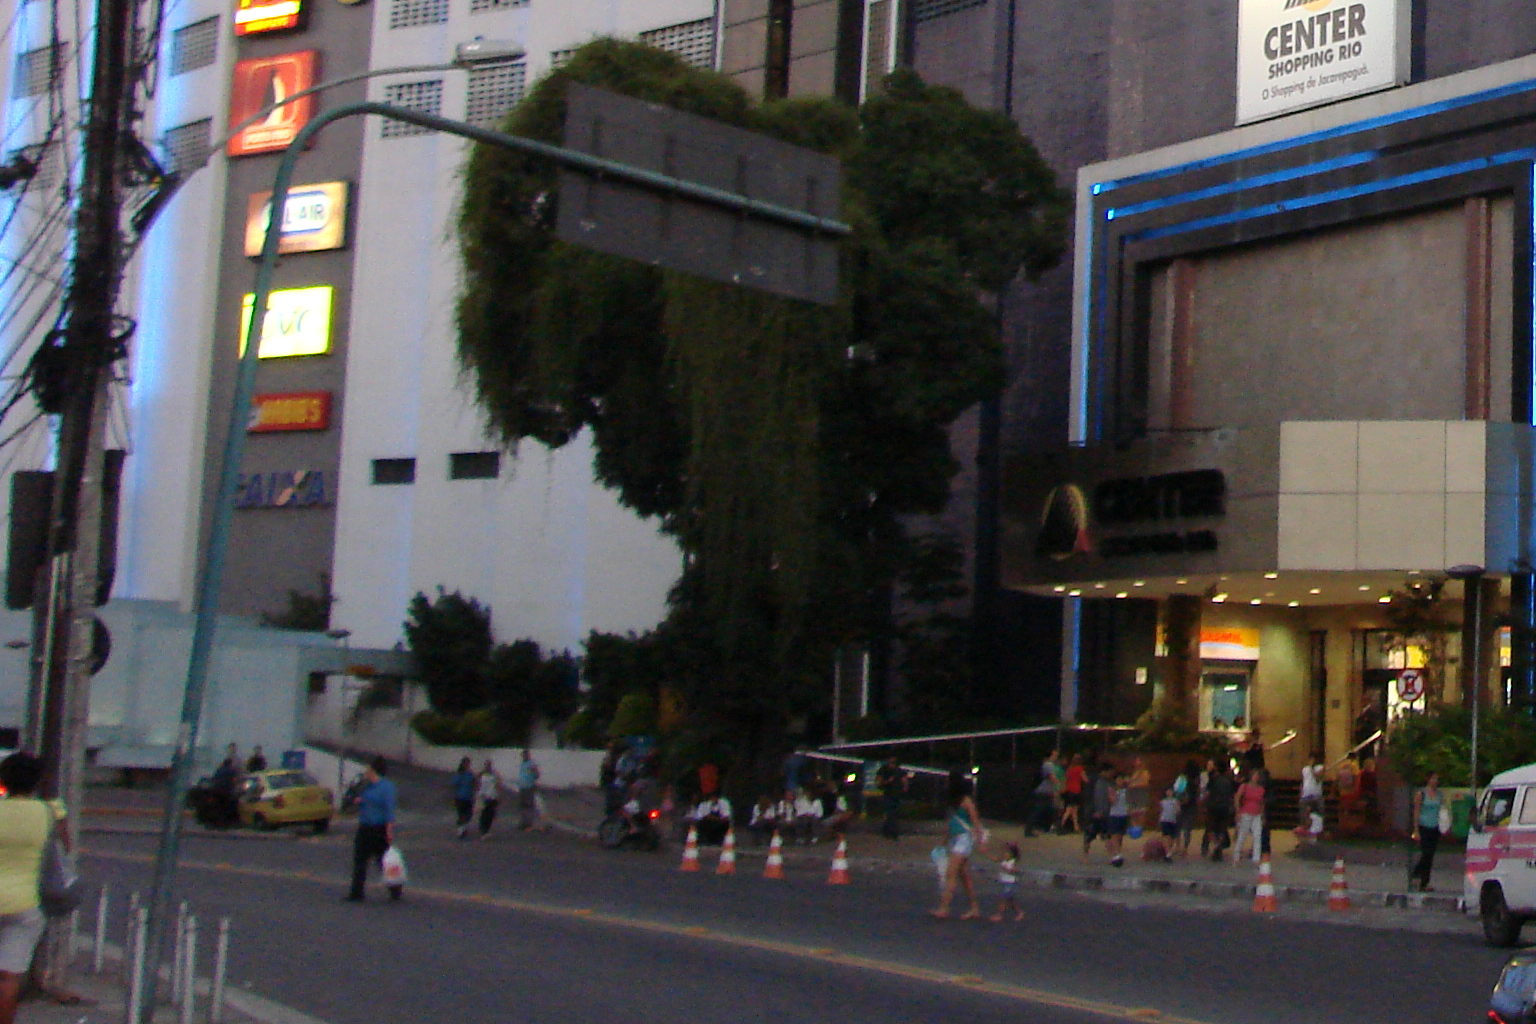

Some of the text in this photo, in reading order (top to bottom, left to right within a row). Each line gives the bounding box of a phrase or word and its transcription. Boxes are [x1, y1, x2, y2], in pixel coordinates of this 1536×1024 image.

[1263, 3, 1367, 61] CENTER
[1267, 40, 1363, 80] SHOPPING RIO
[1261, 88, 1270, 101] O
[1270, 79, 1305, 98] Shopping
[1306, 75, 1317, 89] de
